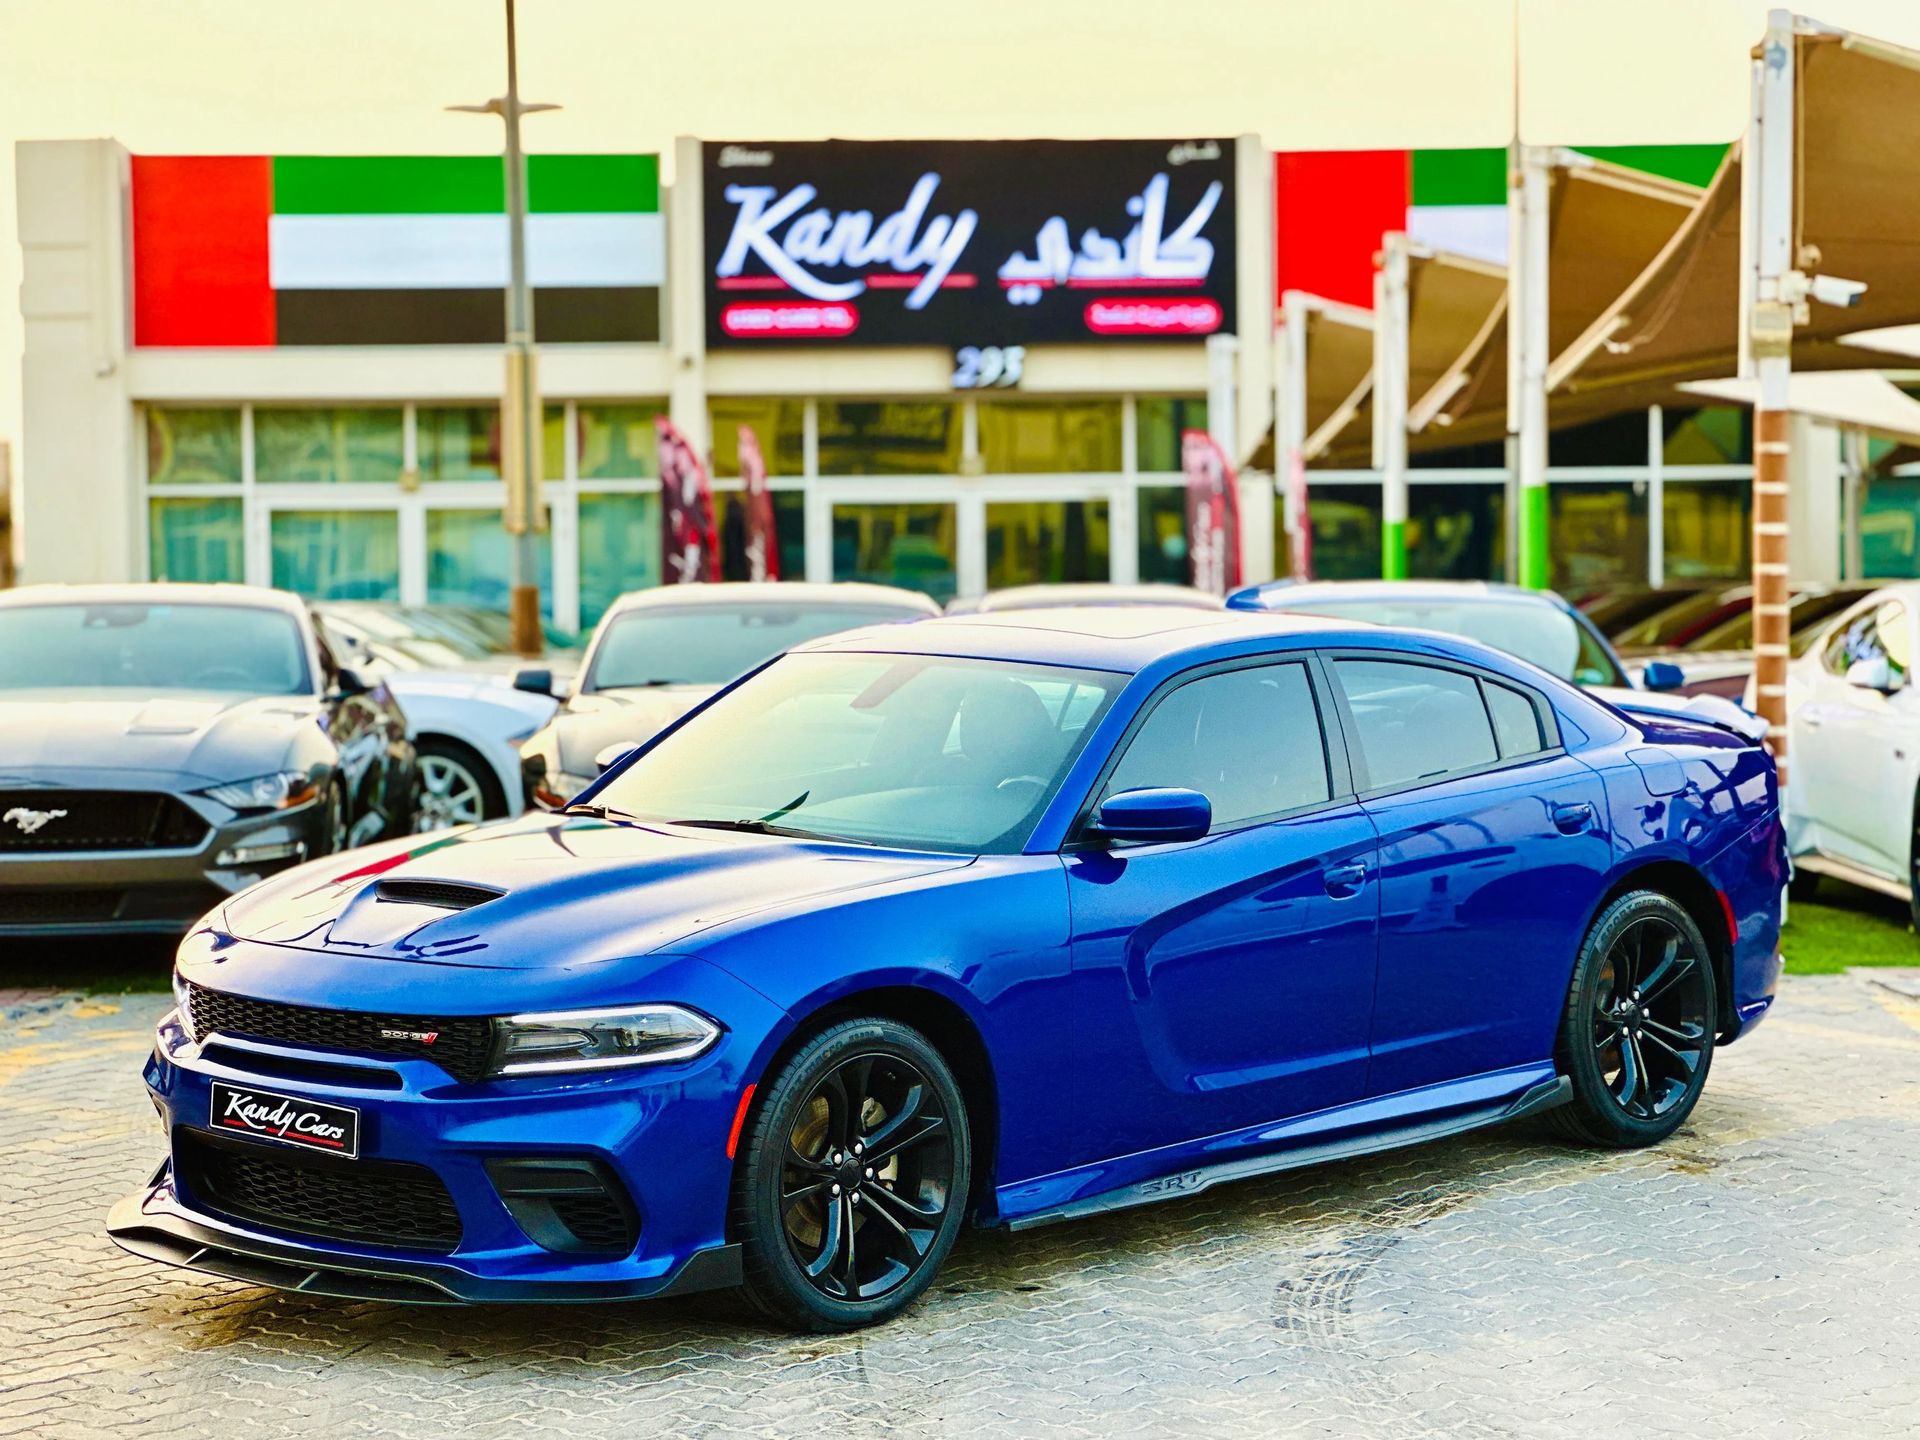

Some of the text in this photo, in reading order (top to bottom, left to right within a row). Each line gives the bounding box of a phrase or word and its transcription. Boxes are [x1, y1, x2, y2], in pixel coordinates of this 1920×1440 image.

[717, 171, 978, 309] Kandy
[998, 172, 1223, 305] كاندي
[951, 345, 1025, 388] 295
[224, 1091, 345, 1139] Kandy Cars
[1141, 1170, 1201, 1195] SRT
